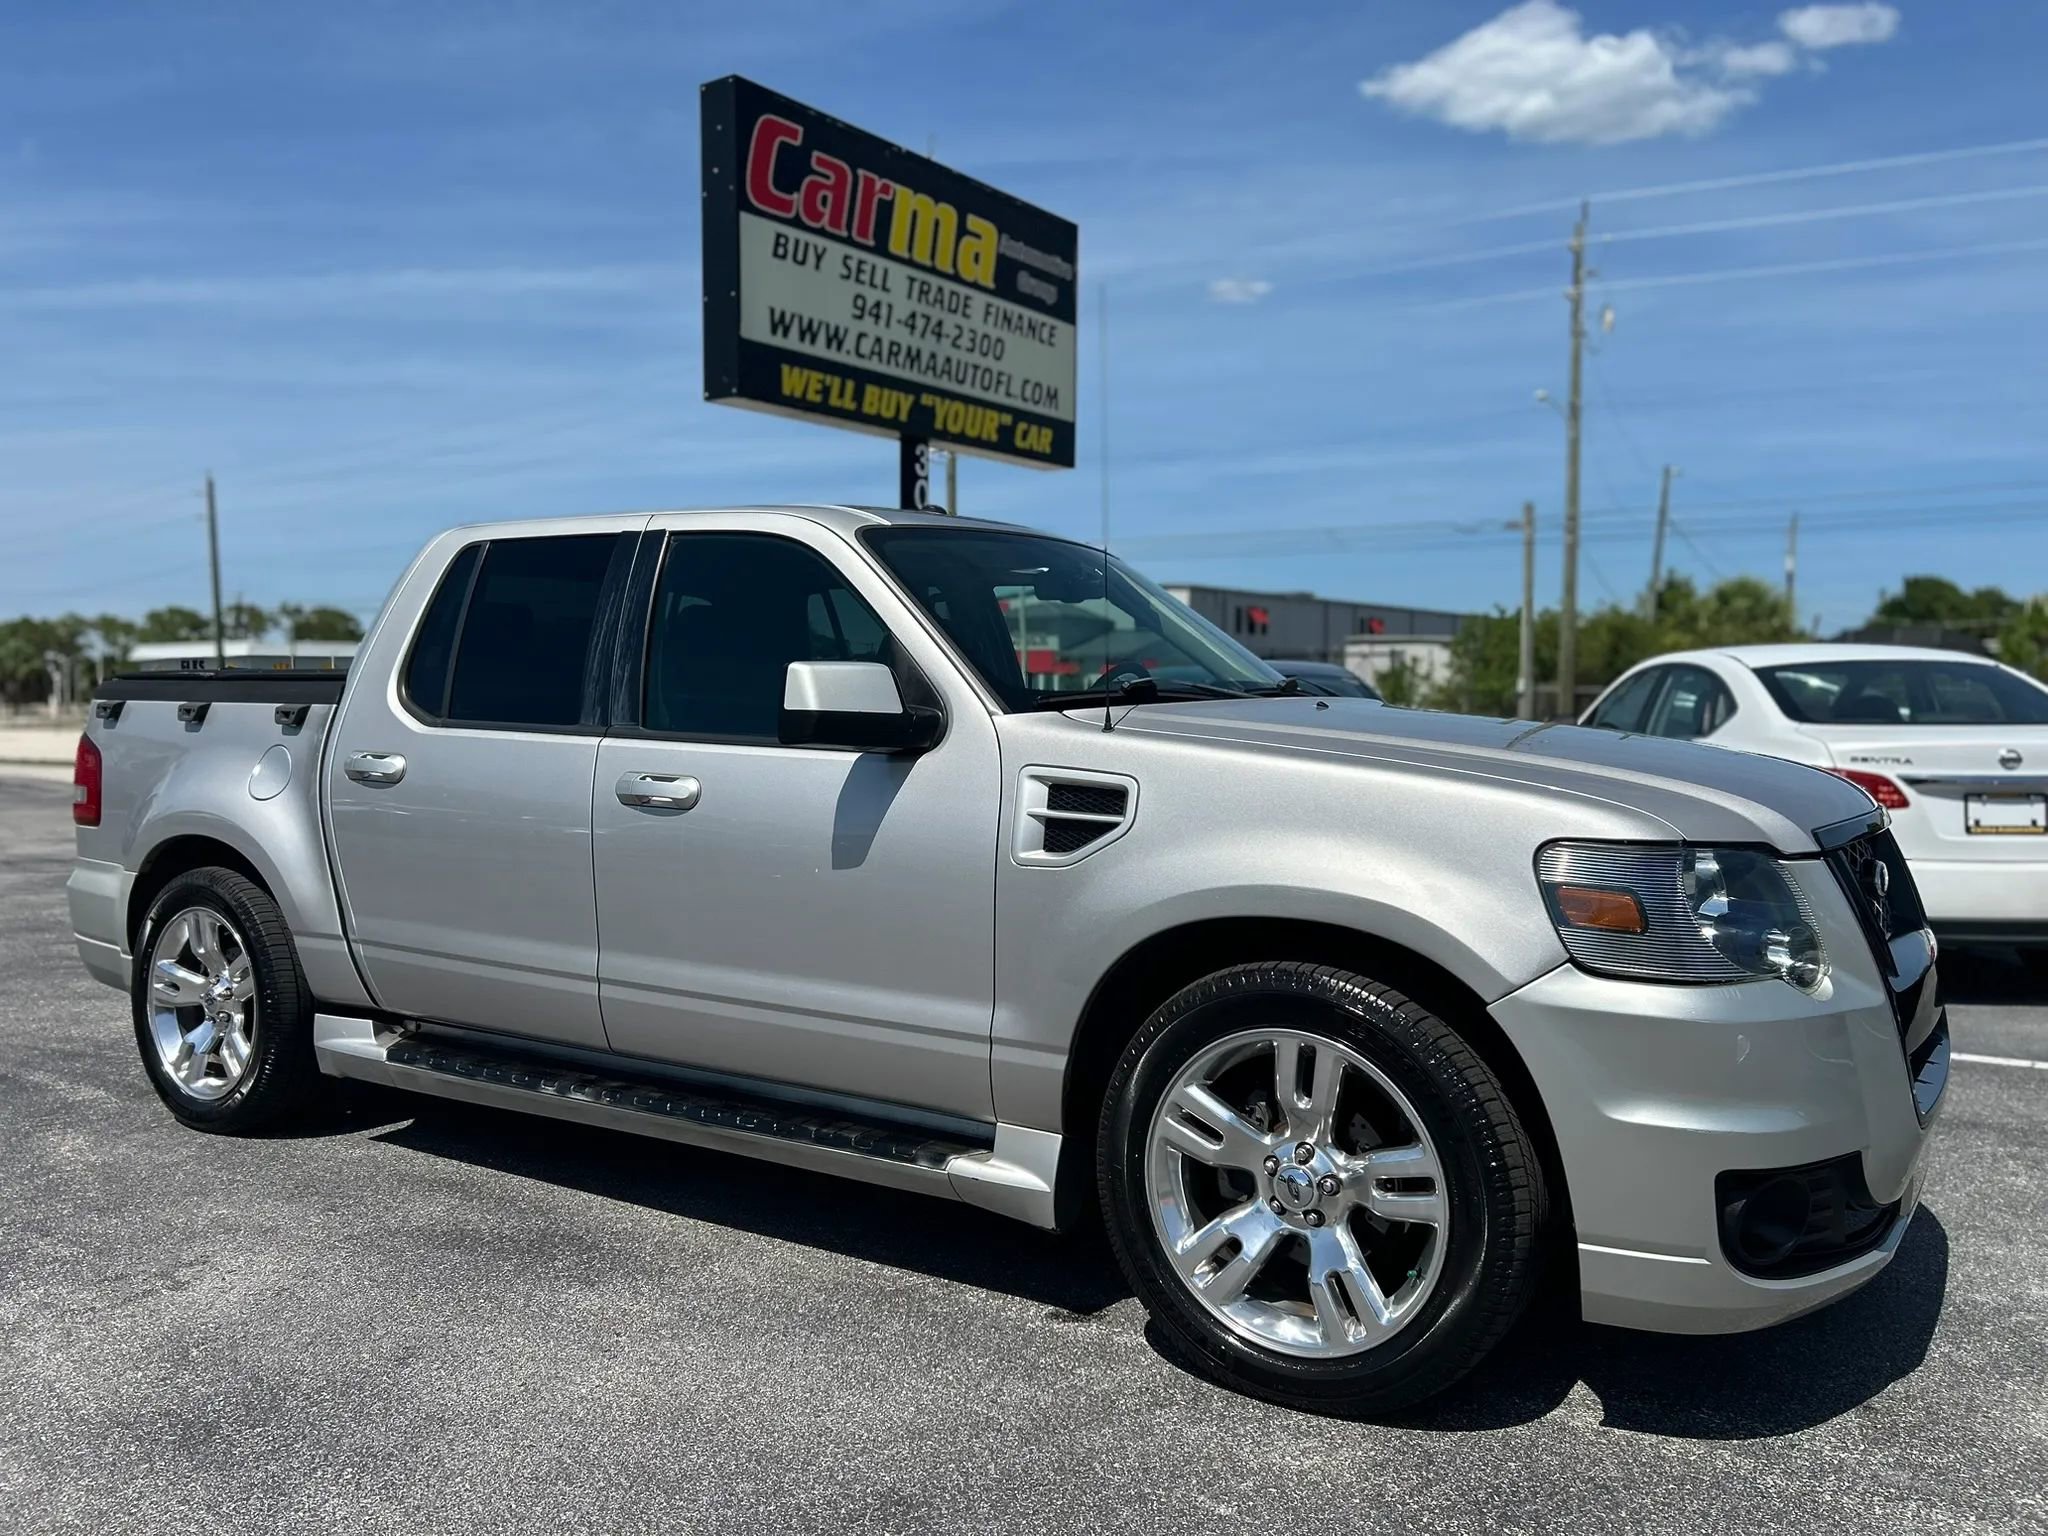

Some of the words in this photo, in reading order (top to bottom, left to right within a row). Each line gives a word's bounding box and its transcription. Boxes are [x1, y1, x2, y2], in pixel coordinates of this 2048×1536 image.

[746, 114, 999, 289] Carma
[772, 231, 827, 272] BUY
[839, 253, 891, 293] SELL
[906, 275, 973, 319] TRADE
[983, 301, 1057, 348] FINANCE
[851, 293, 1005, 361] 941-474-2300
[768, 305, 1060, 411] WWW.CARMAAUTOFL.COM
[780, 363, 857, 410] WE'LL
[862, 383, 915, 423] BUY
[920, 392, 1012, 443] "YOUR"
[1014, 421, 1054, 454] CAR
[1850, 756, 1913, 766] SENTRA
